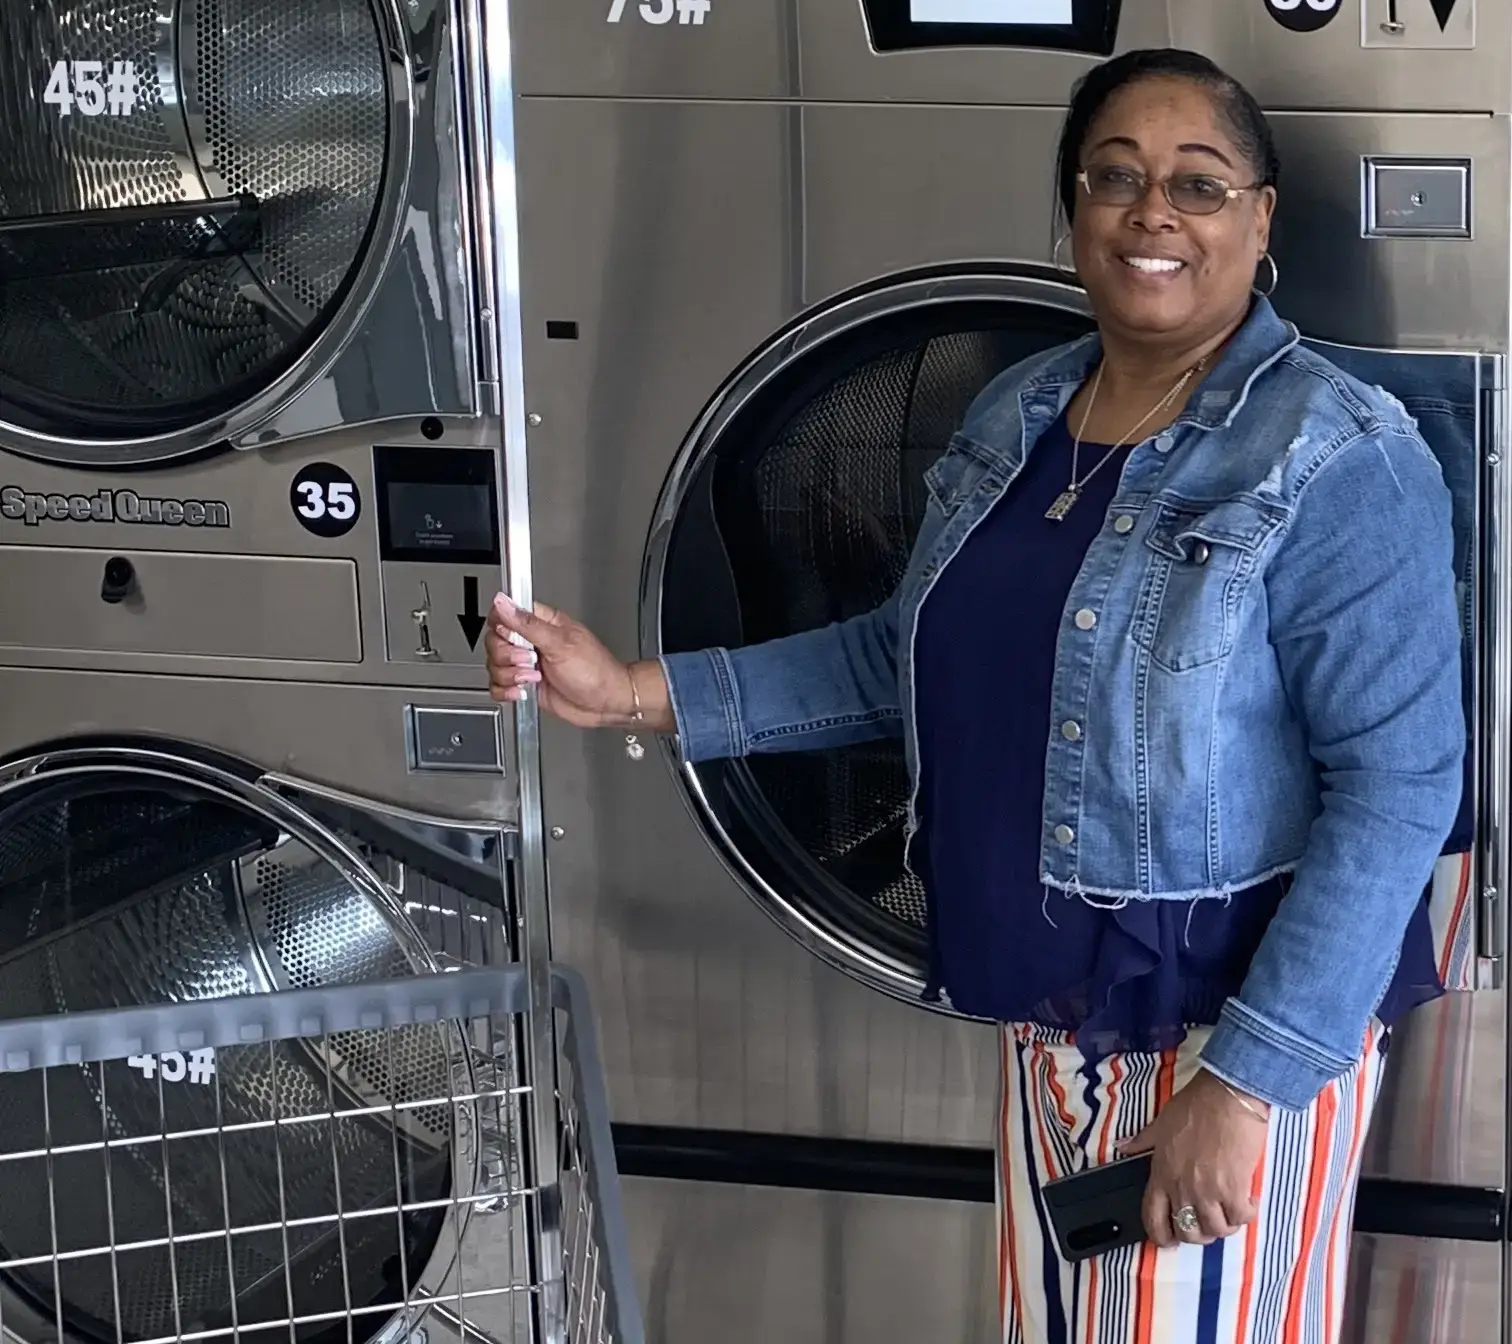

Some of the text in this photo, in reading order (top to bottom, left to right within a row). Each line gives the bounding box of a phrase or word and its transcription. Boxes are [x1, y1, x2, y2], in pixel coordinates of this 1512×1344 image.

[44, 60, 140, 116] 45#
[0, 485, 231, 528] Speed Queen
[297, 482, 356, 521] 35
